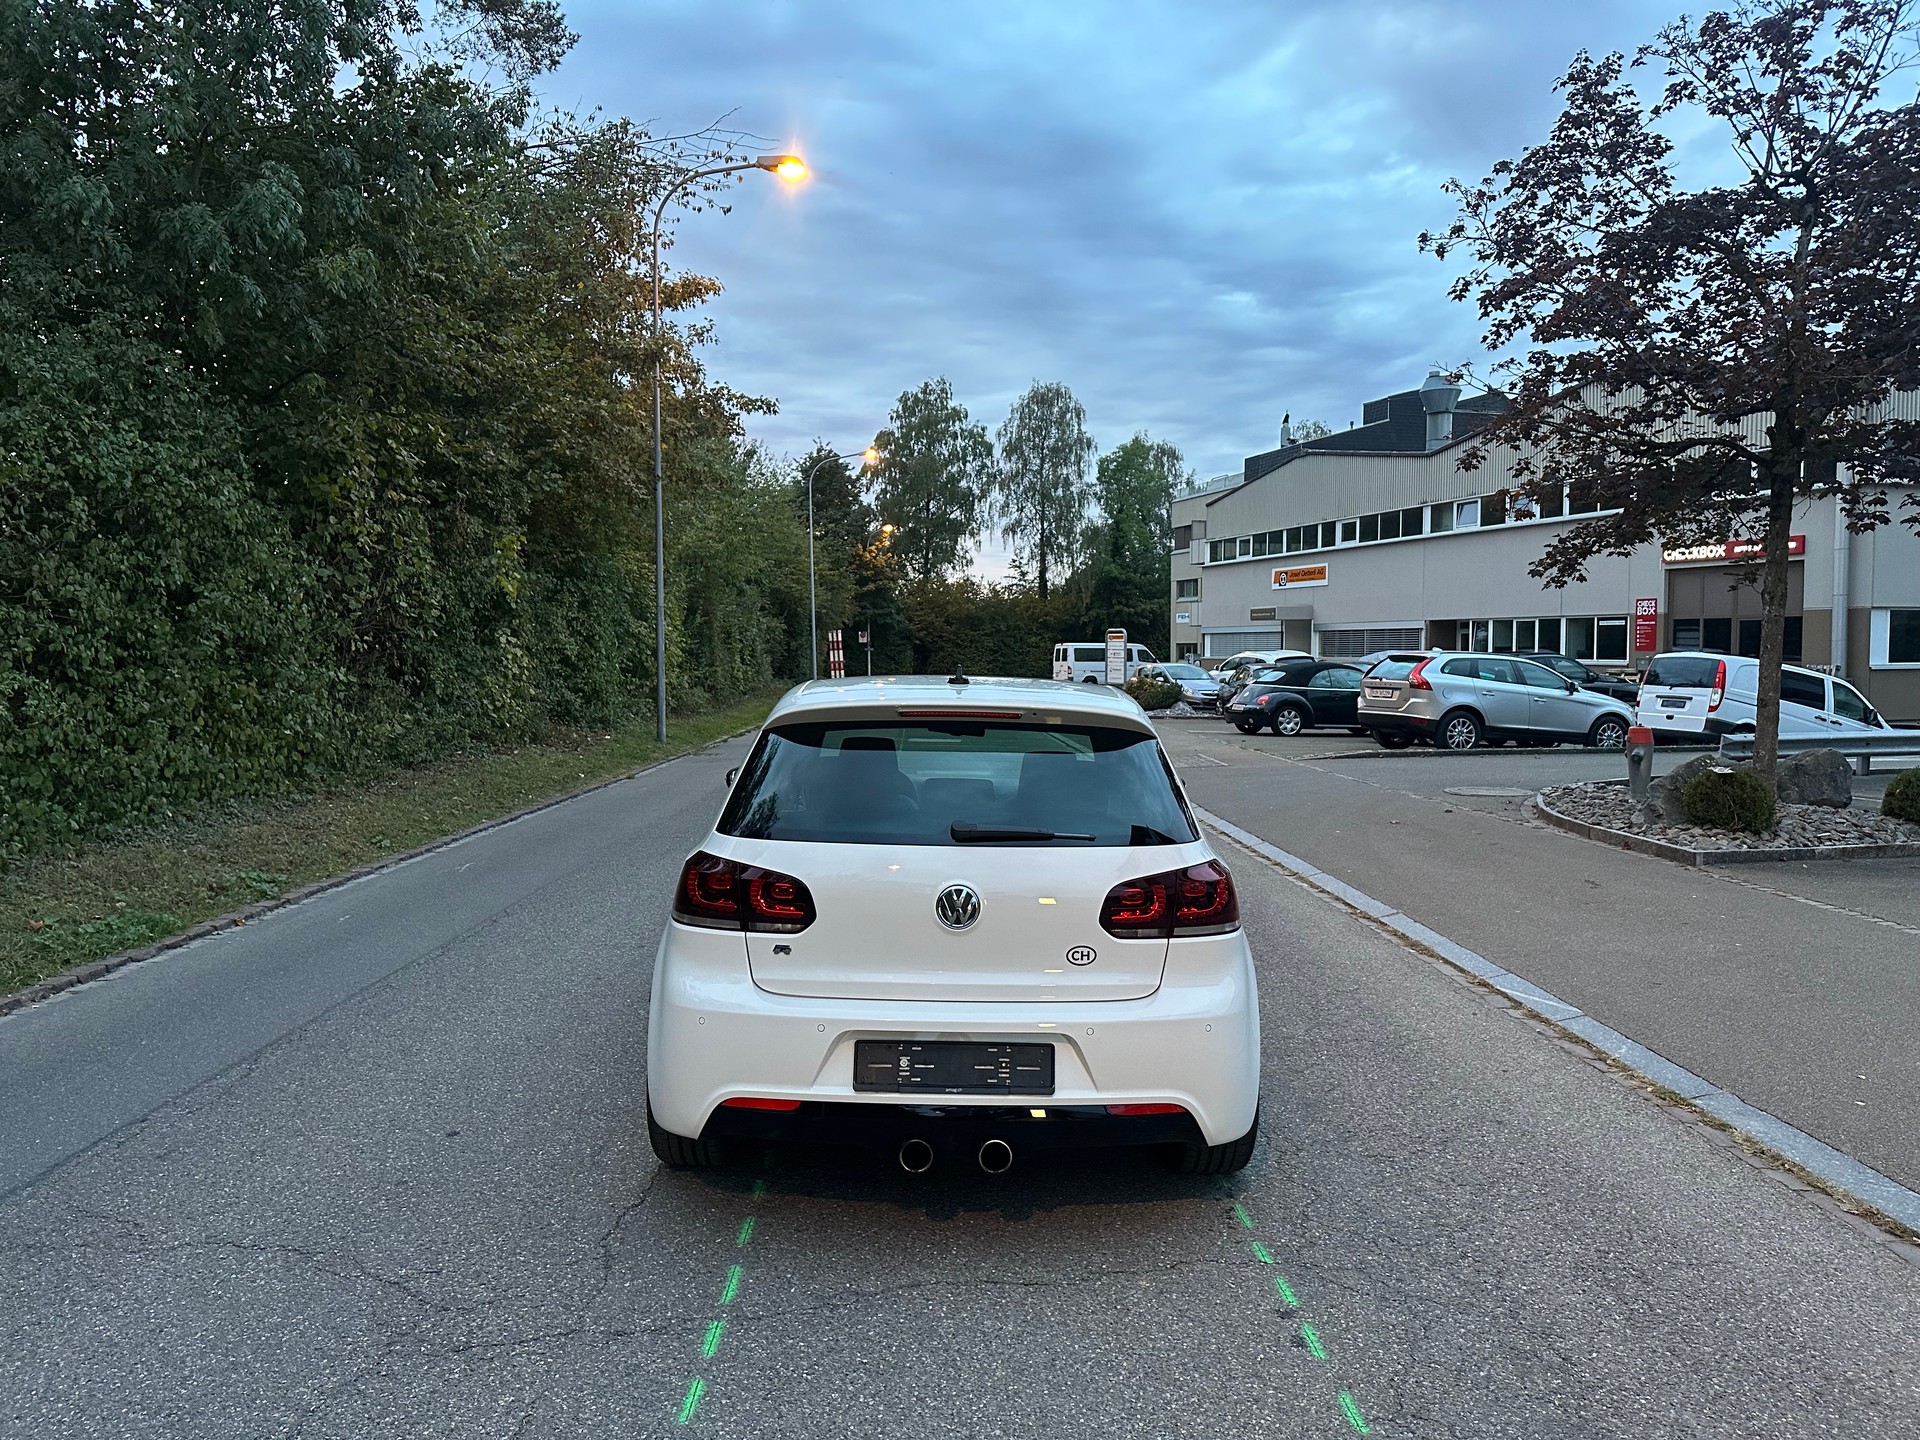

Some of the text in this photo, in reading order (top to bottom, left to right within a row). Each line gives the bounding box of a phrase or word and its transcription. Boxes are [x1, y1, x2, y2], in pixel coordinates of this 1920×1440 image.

[1637, 606, 1656, 615] BOX
[938, 886, 979, 928] VW
[1071, 950, 1091, 961] CH
